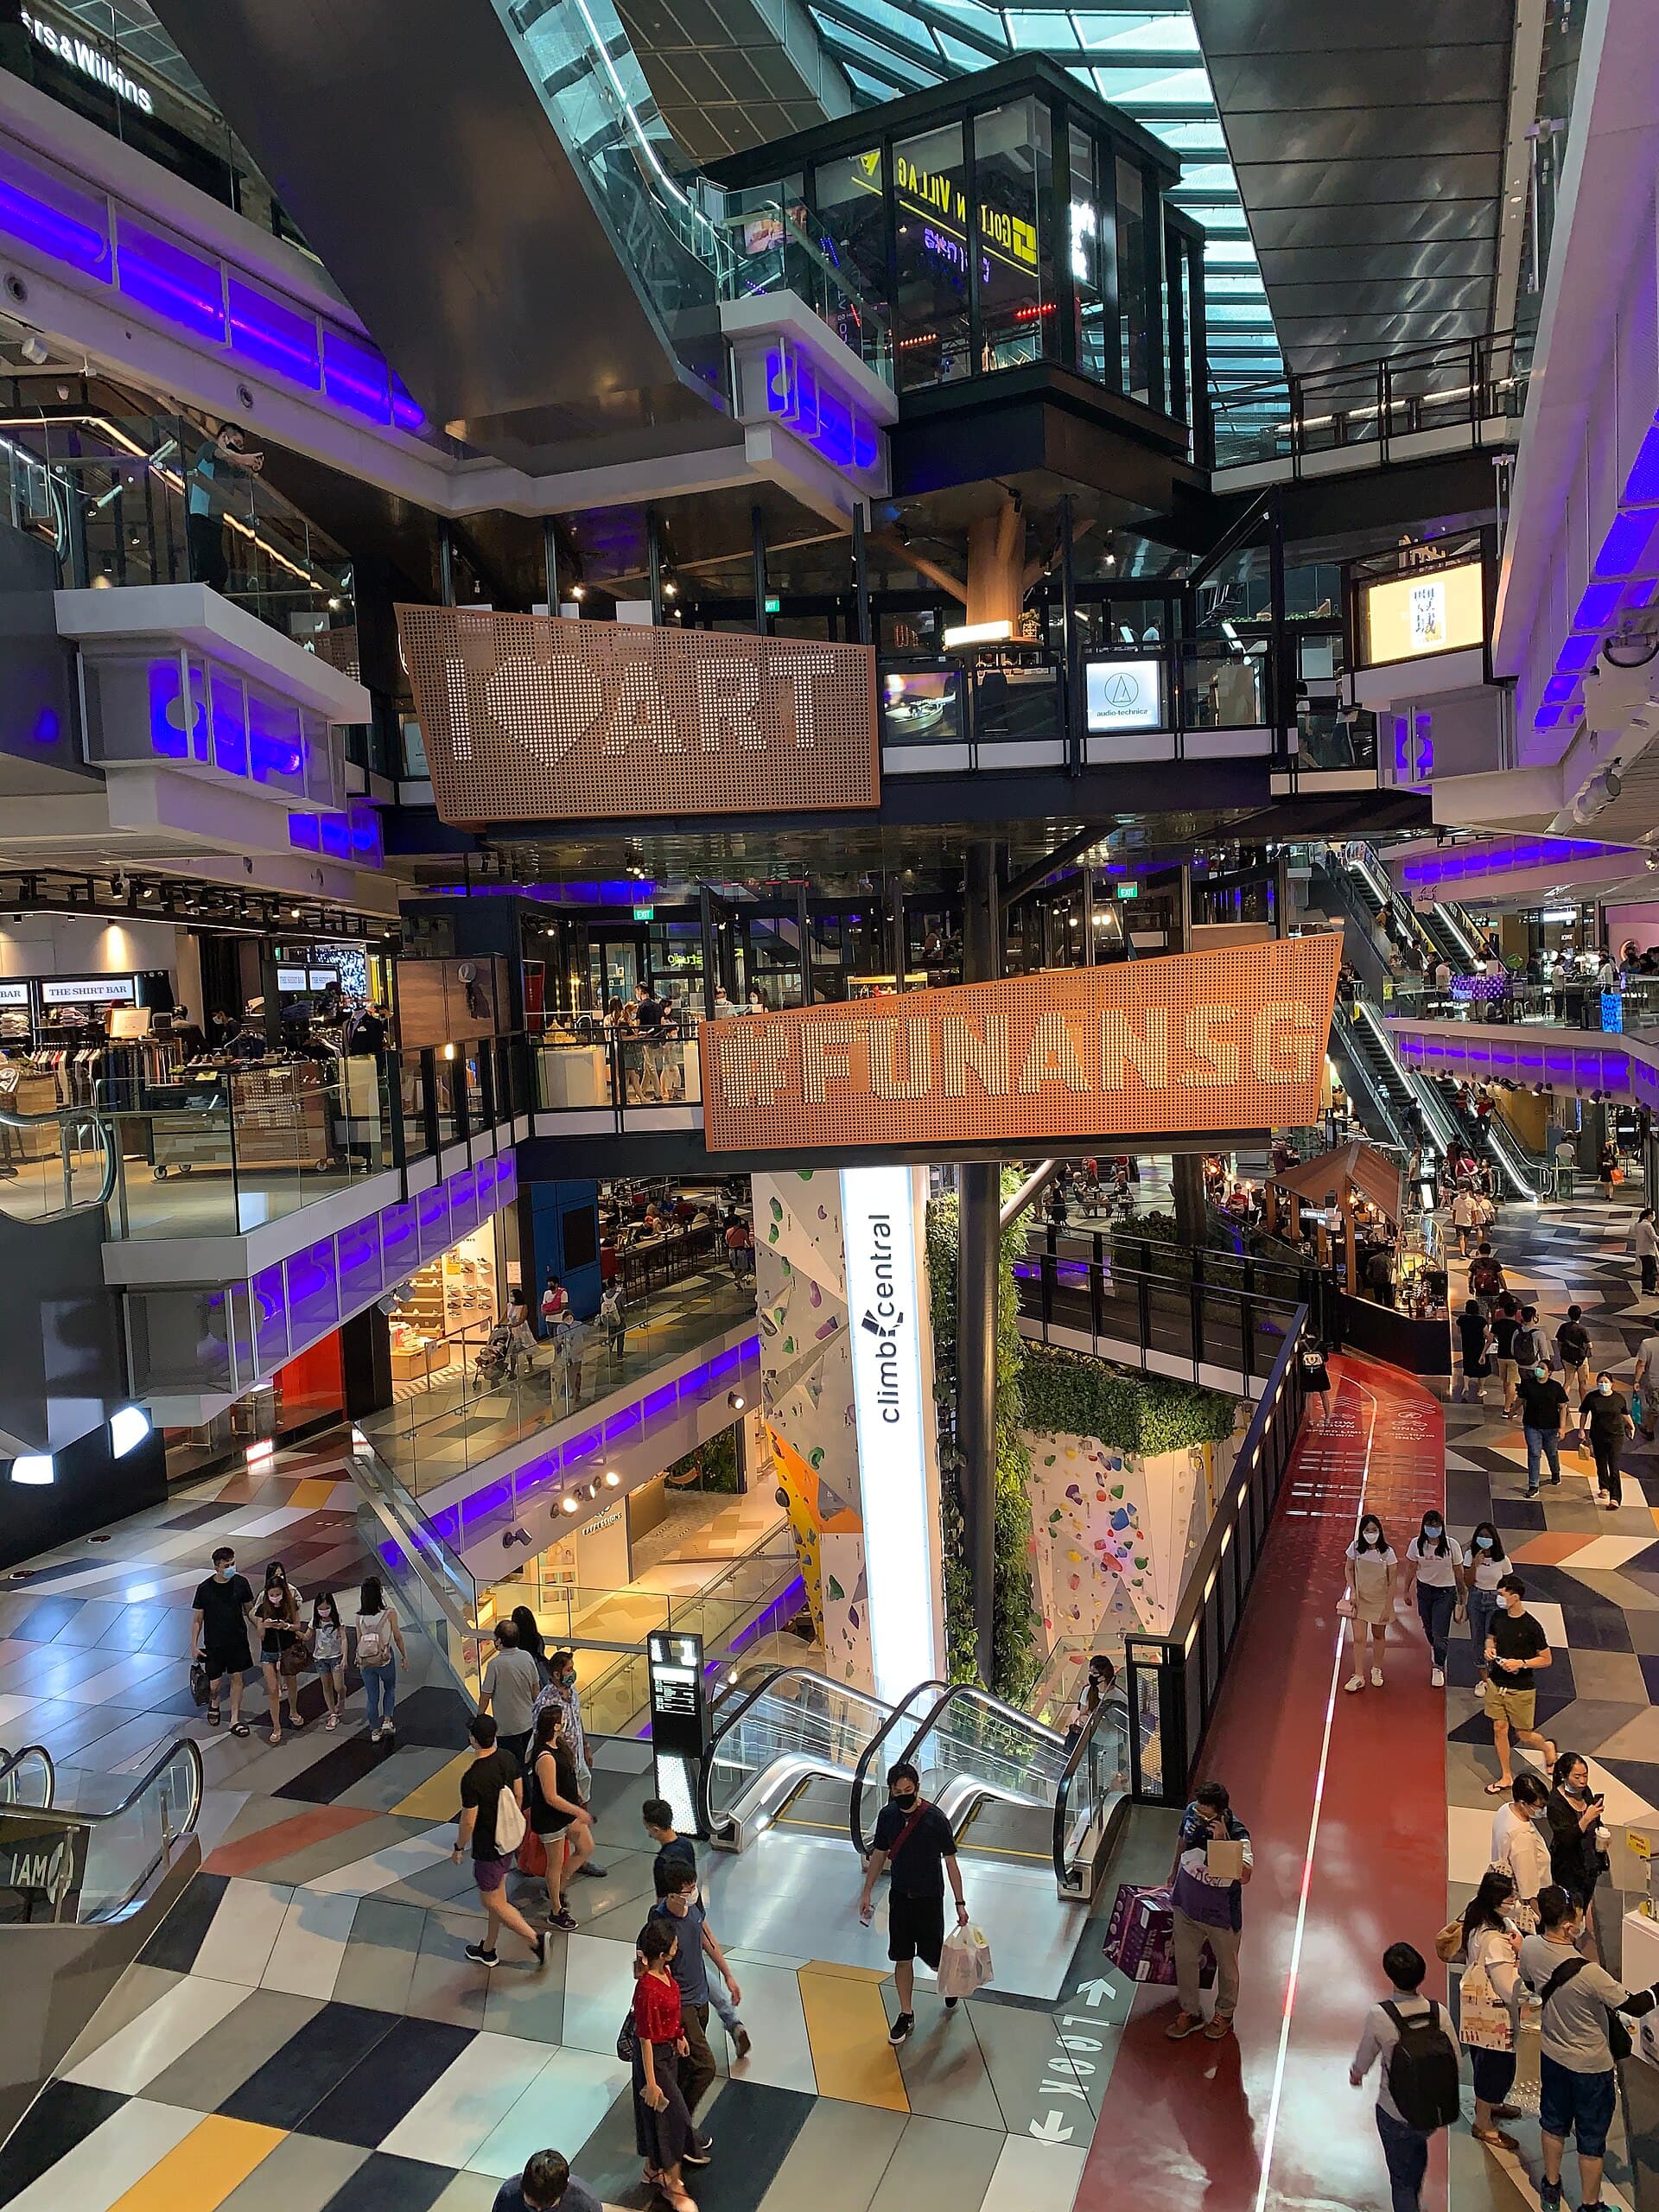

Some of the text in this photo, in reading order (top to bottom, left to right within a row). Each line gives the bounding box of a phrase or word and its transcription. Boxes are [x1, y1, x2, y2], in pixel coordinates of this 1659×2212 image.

[445, 654, 836, 761] I ART
[1096, 708, 1148, 717] audio-technica
[637, 910, 651, 919] EXIT
[72, 987, 105, 995] SHIRT
[720, 999, 1317, 1108] #FUNANSG
[868, 1214, 900, 1424] climb central
[582, 1511, 622, 1535] EXPRESSIONS
[1039, 2013, 1110, 2101] LOOK
